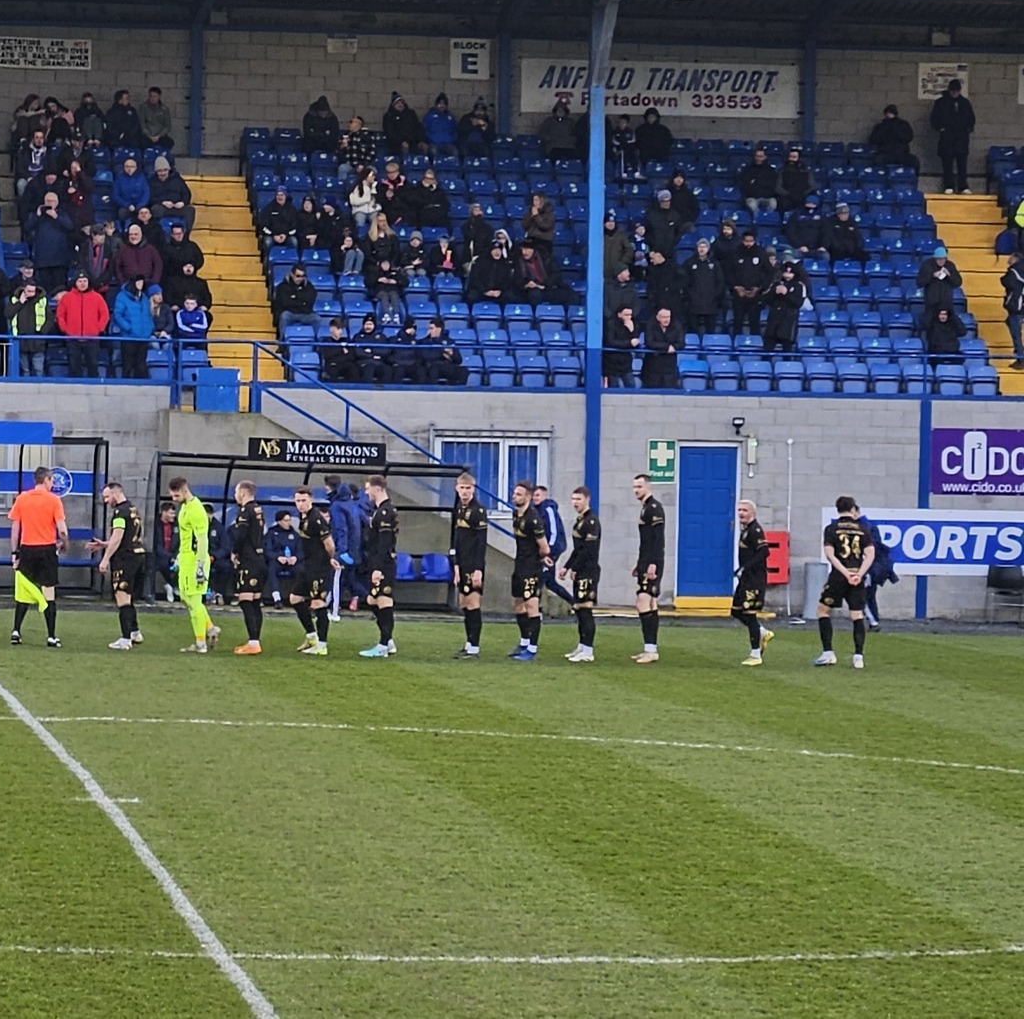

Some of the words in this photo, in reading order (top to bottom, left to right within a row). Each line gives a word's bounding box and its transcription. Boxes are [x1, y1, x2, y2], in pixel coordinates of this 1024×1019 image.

[453, 42, 486, 50] BLOCK
[461, 53, 478, 74] E
[538, 65, 636, 90] ANFLD
[646, 68, 779, 94] TRANSPORT
[581, 92, 678, 108] Prtadown
[286, 440, 378, 458] MALCOMSONS
[286, 454, 326, 462] FUNERAL
[329, 455, 366, 464] SERVICE
[839, 534, 861, 559] 34
[877, 524, 1023, 561] PORTS
